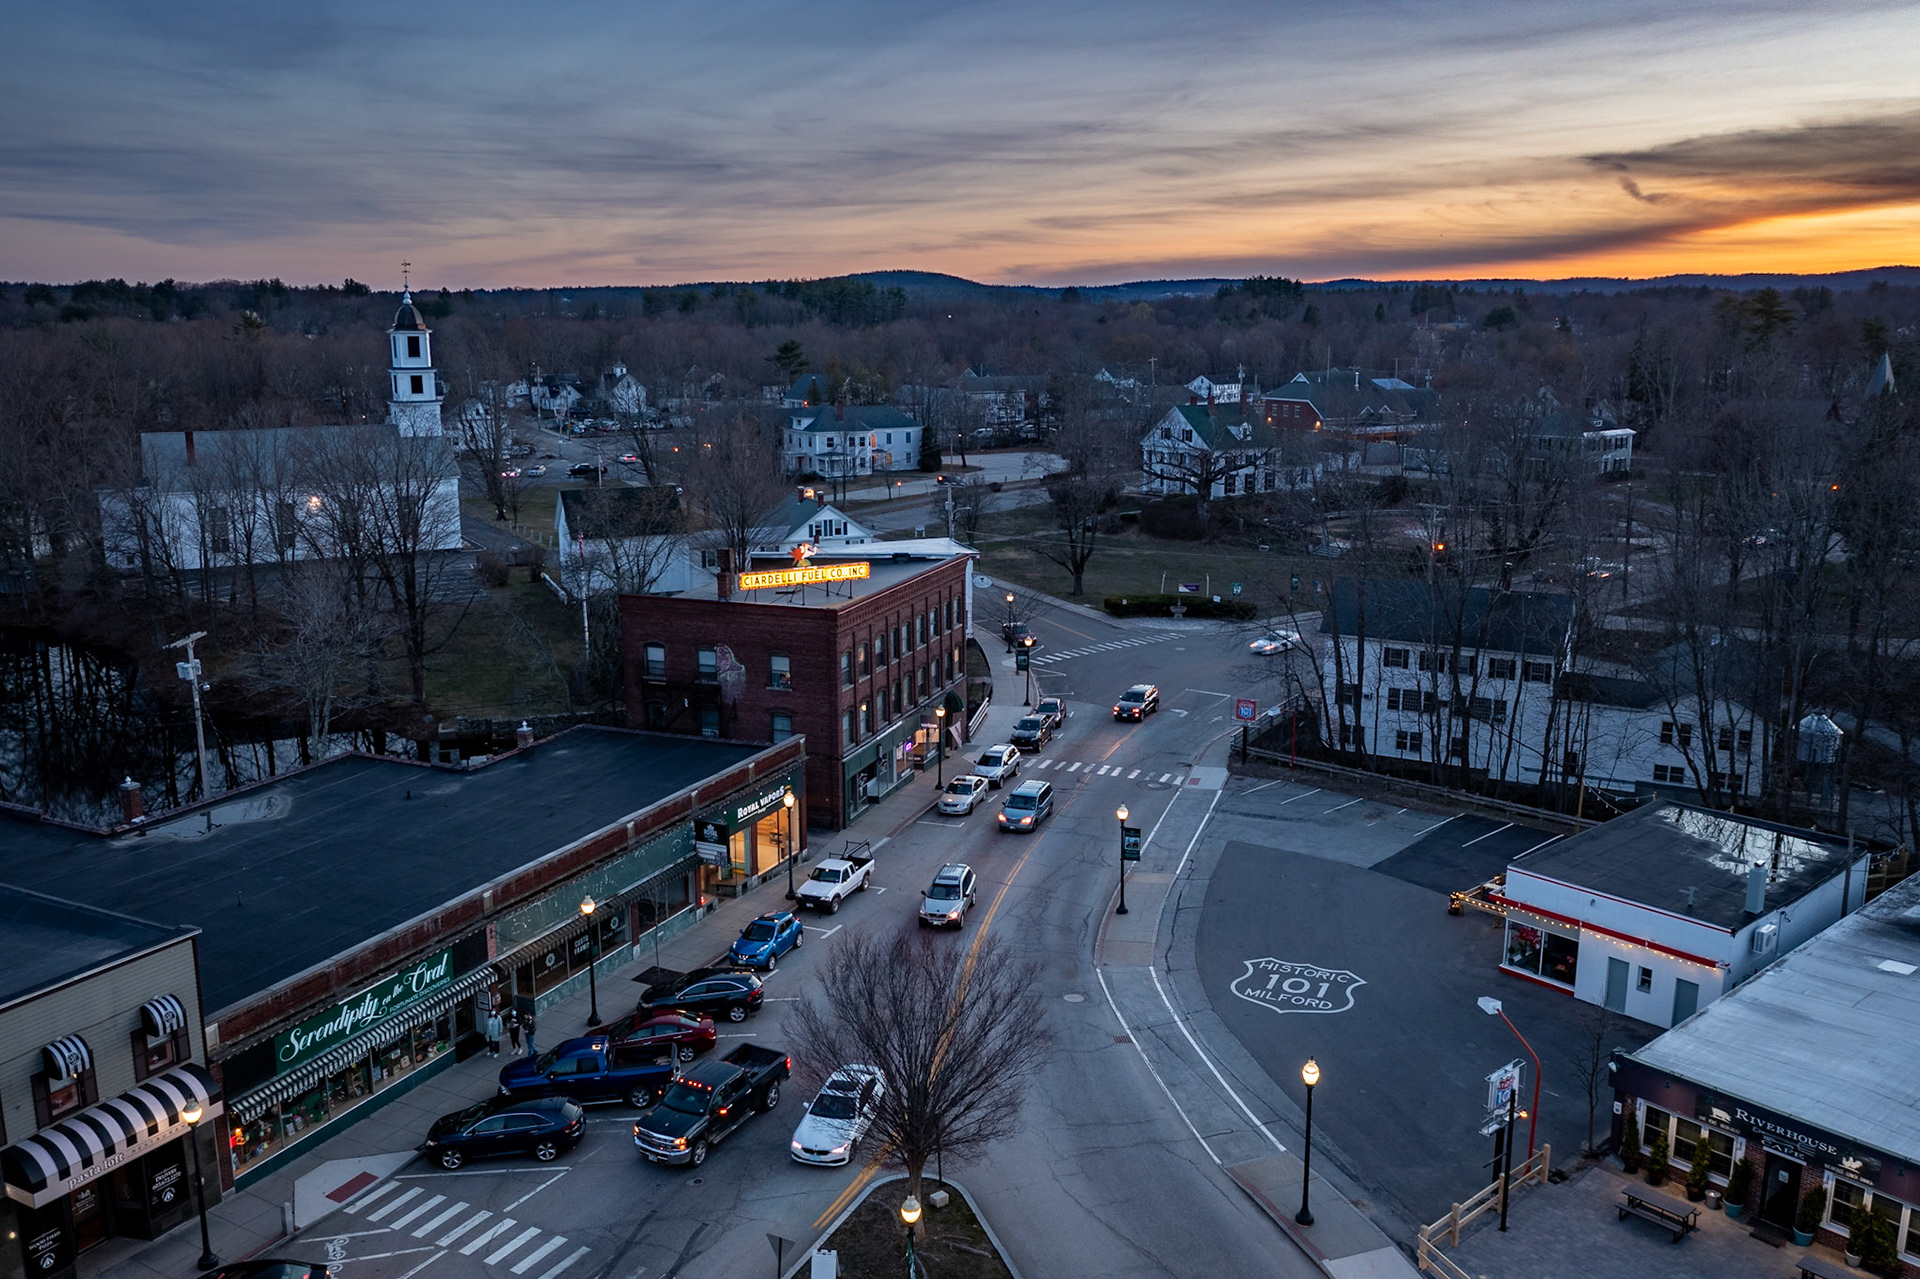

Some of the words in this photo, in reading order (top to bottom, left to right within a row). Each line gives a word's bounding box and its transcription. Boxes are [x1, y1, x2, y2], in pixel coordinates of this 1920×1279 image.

[743, 573, 797, 586] CIARDELLI
[801, 569, 826, 581] FUEL
[1240, 707, 1252, 715] 101
[737, 801, 759, 819] ROYAL
[760, 785, 785, 807] VAPORS
[1259, 961, 1350, 983] HISTORIC
[1266, 973, 1330, 999] 101
[279, 992, 388, 1062] Serendipity
[382, 994, 392, 1006] on
[392, 982, 404, 998] the
[403, 953, 449, 994] Oval
[389, 993, 419, 1013] FORTUNATE
[419, 976, 451, 999] DISCOVERIES
[1244, 988, 1333, 1010] MILFORD
[1735, 1107, 1837, 1156] RIVERHOUSE
[68, 1165, 102, 1190] pasta
[103, 1152, 125, 1171] loft
[130, 1123, 187, 1154] RESTAURAN
